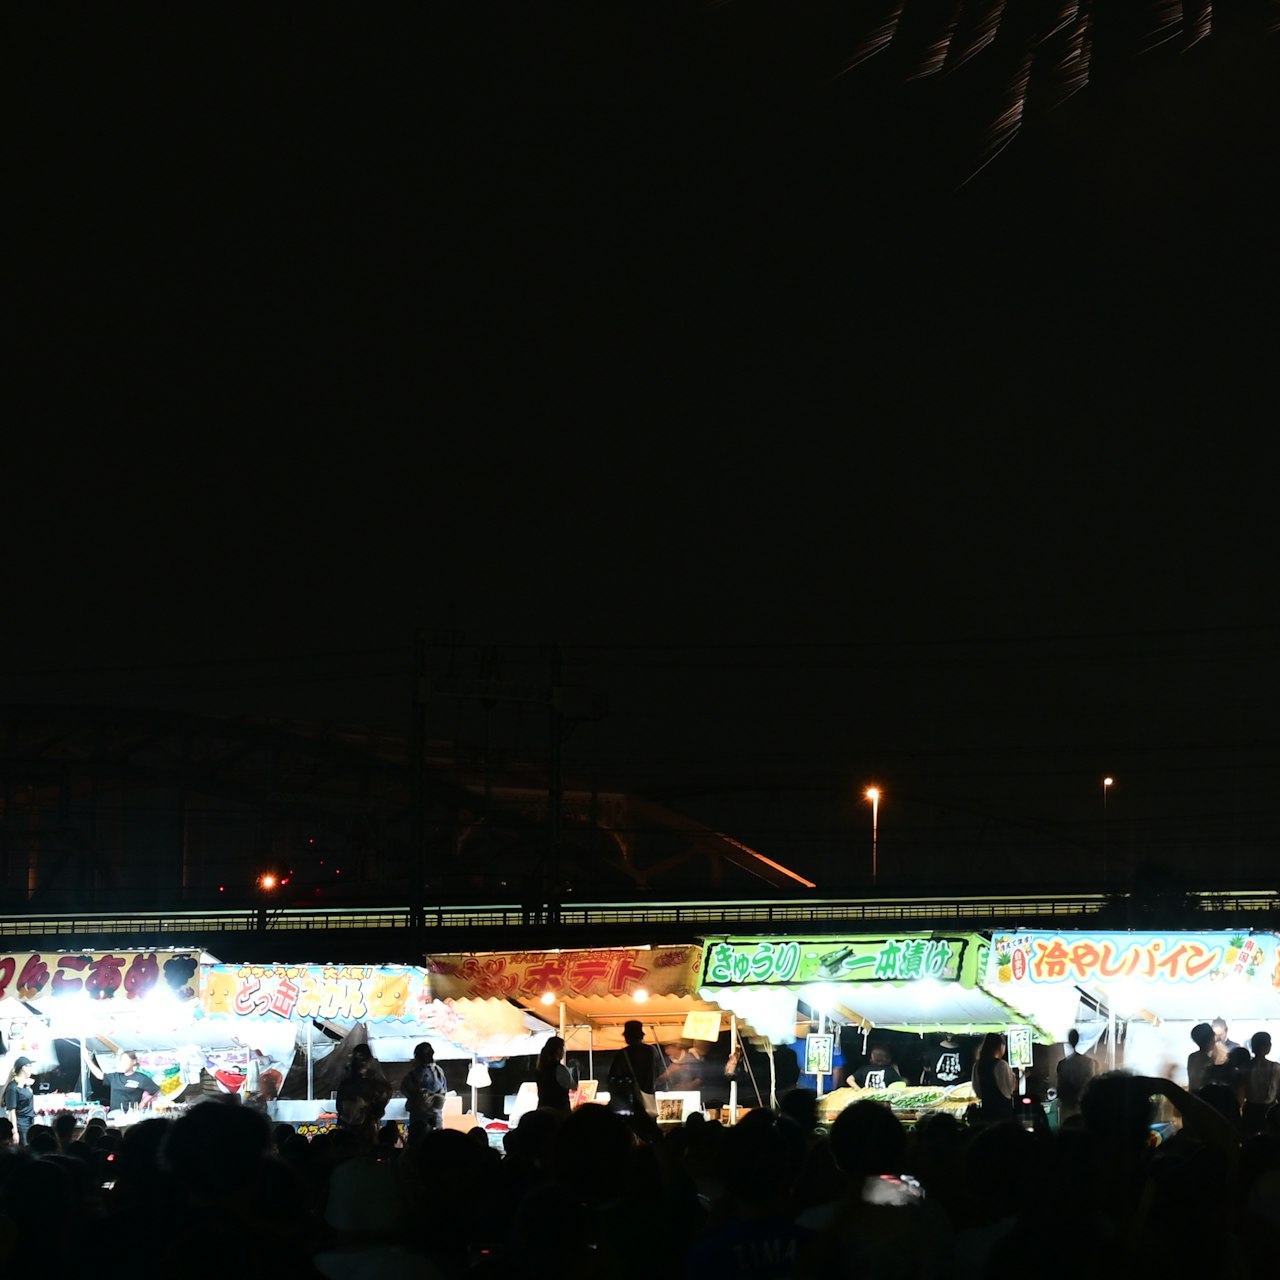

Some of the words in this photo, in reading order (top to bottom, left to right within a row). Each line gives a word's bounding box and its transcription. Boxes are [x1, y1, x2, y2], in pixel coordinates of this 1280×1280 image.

[519, 956, 648, 995] ポテト
[711, 941, 800, 983] きゅうり
[844, 939, 953, 981] 一本漬け
[1033, 939, 1218, 979] 冷やしパイン
